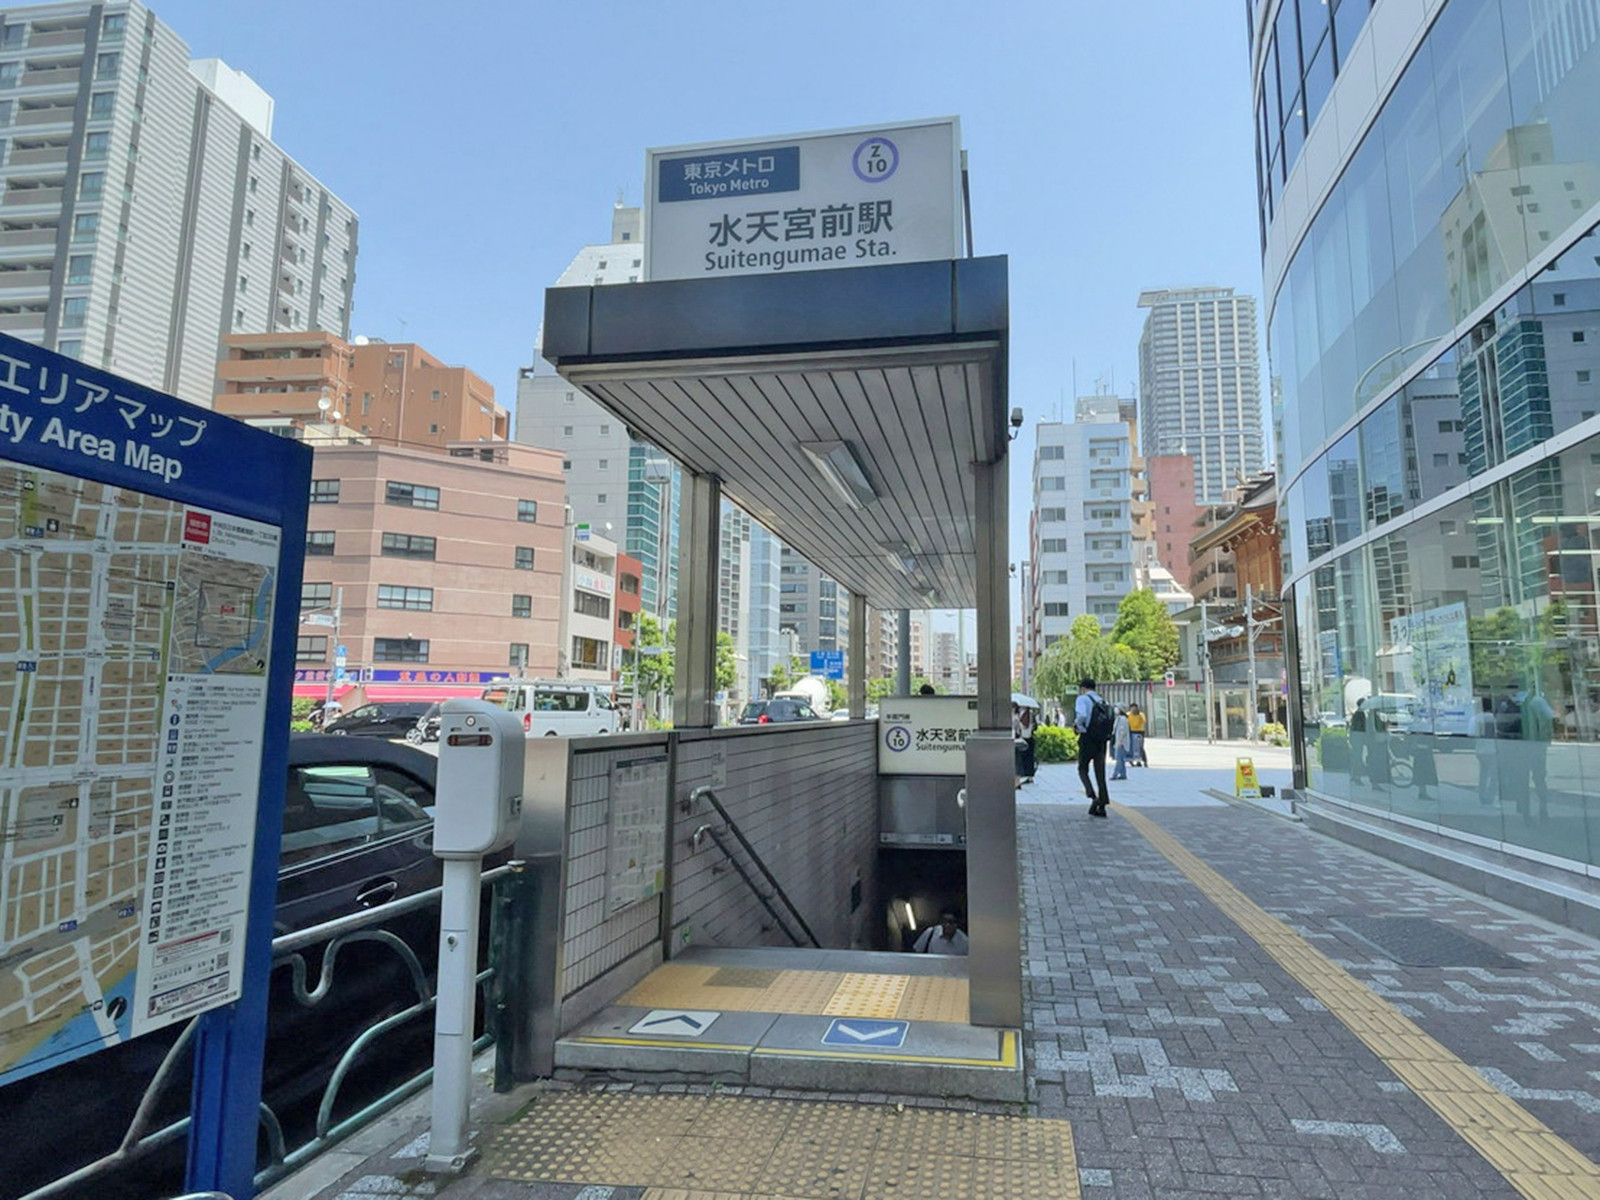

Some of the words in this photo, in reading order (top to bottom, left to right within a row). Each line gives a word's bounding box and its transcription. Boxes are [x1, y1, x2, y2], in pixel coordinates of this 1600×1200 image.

[871, 145, 880, 157] Z
[683, 156, 775, 181] 東京メトロ
[866, 159, 887, 173] 10
[689, 181, 727, 196] Tokyo
[730, 177, 770, 191] Metro
[708, 199, 894, 248] 水天宮前駅
[704, 242, 847, 271] Suitengumae
[855, 238, 897, 259] Sta.
[40, 417, 116, 462] Area
[124, 440, 183, 483] Map
[893, 738, 905, 746] 10
[895, 730, 902, 738] Z
[916, 727, 976, 742] 水天宮前
